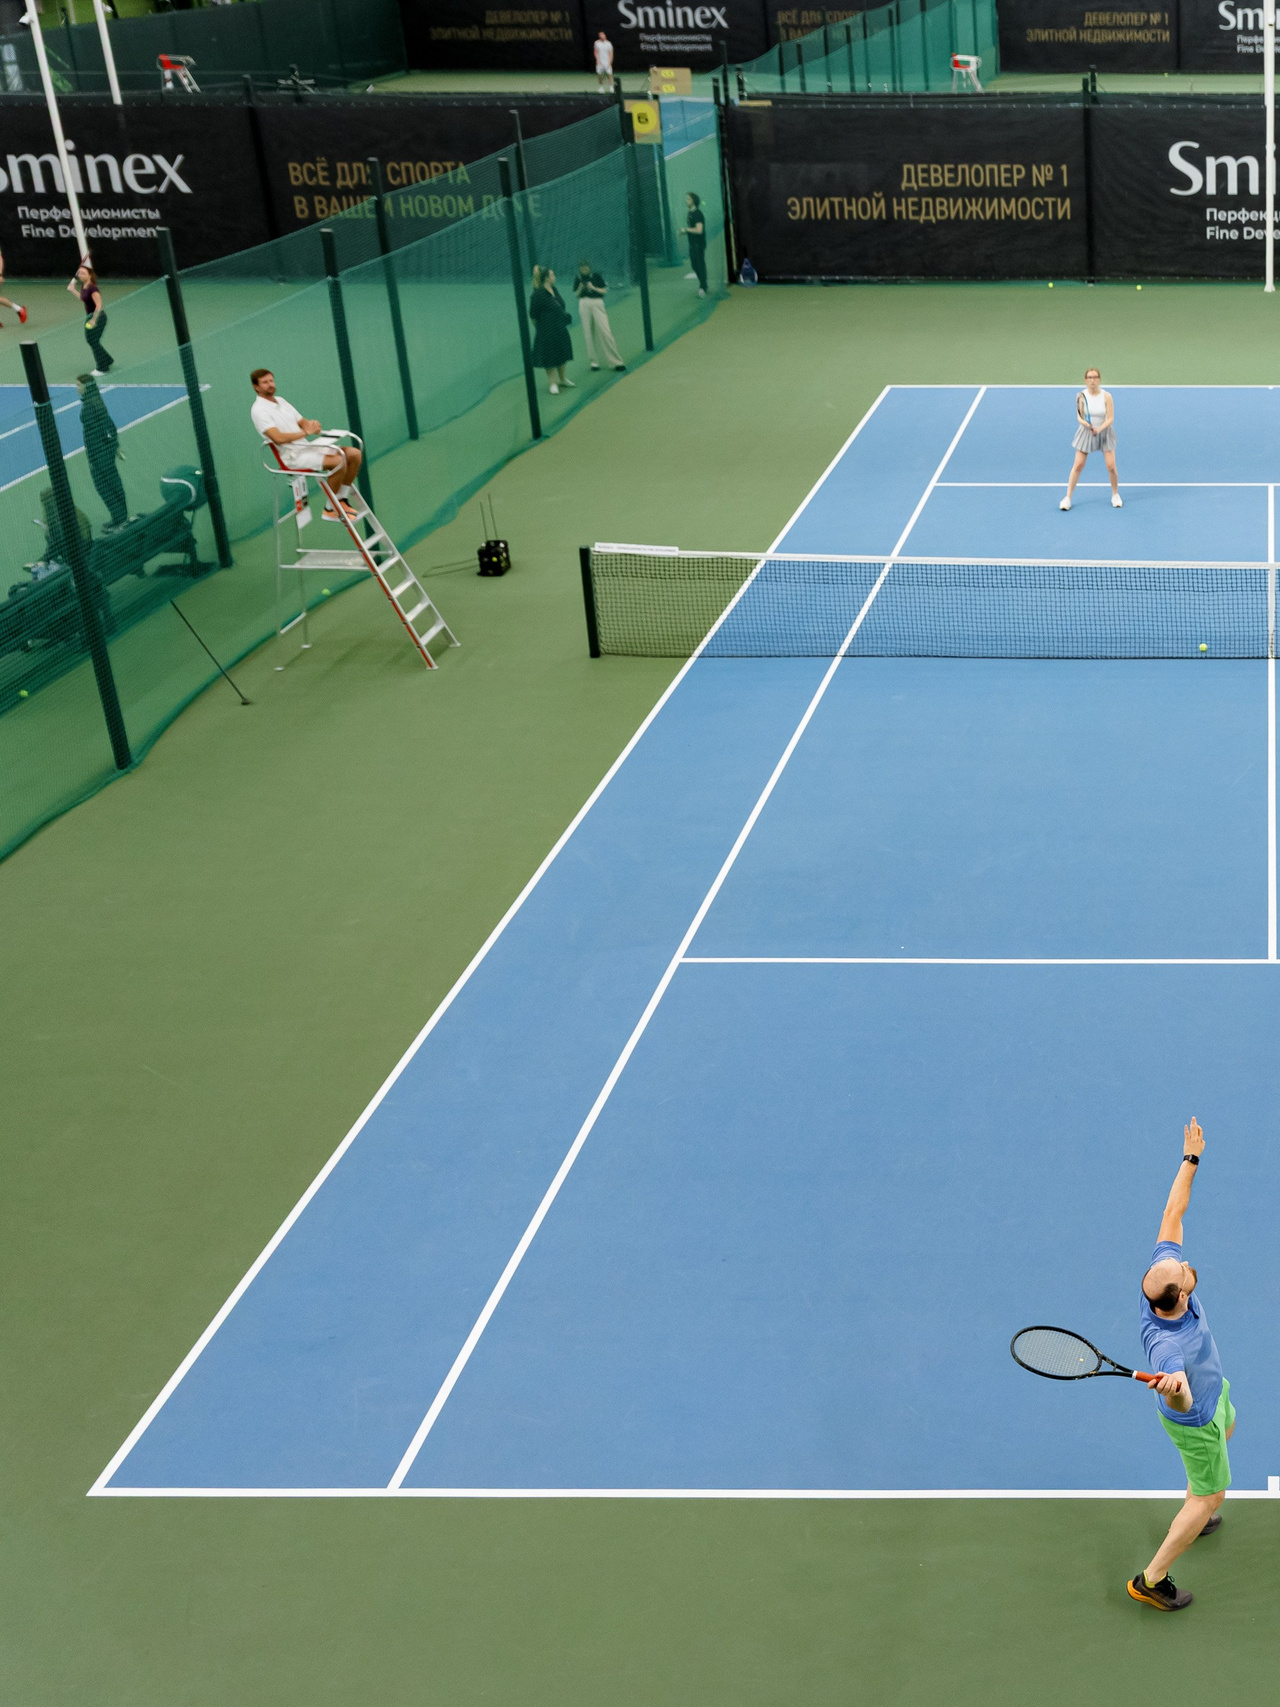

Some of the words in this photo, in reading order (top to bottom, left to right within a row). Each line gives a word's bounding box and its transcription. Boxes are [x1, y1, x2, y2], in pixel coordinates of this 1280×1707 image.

[617, 0, 729, 29] Sminex
[1084, 12, 1147, 27] ДЕВЕЛОПЕР
[1149, 12, 1162, 26] №
[1164, 12, 1169, 26] 1
[1026, 26, 1077, 43] ЭЛИТНОЙ
[1079, 28, 1170, 44] НЕДВИЖИМОСТИ
[0, 139, 193, 195] minex
[288, 157, 331, 187] ВСЁ
[386, 161, 472, 187] СПОРТА
[902, 164, 1025, 191] ДЕВЕЛОПЕР
[1032, 164, 1054, 187] №
[1060, 164, 1068, 187] 1
[17, 205, 161, 222] Перфеционисты
[293, 195, 310, 220] В
[400, 193, 475, 220] НОВОМ
[787, 191, 886, 221] ЭЛИТНОЙ
[893, 197, 1072, 224] НЕДВИЖИМОСТИ
[21, 223, 56, 239] Fine
[1206, 225, 1239, 240] Fine
